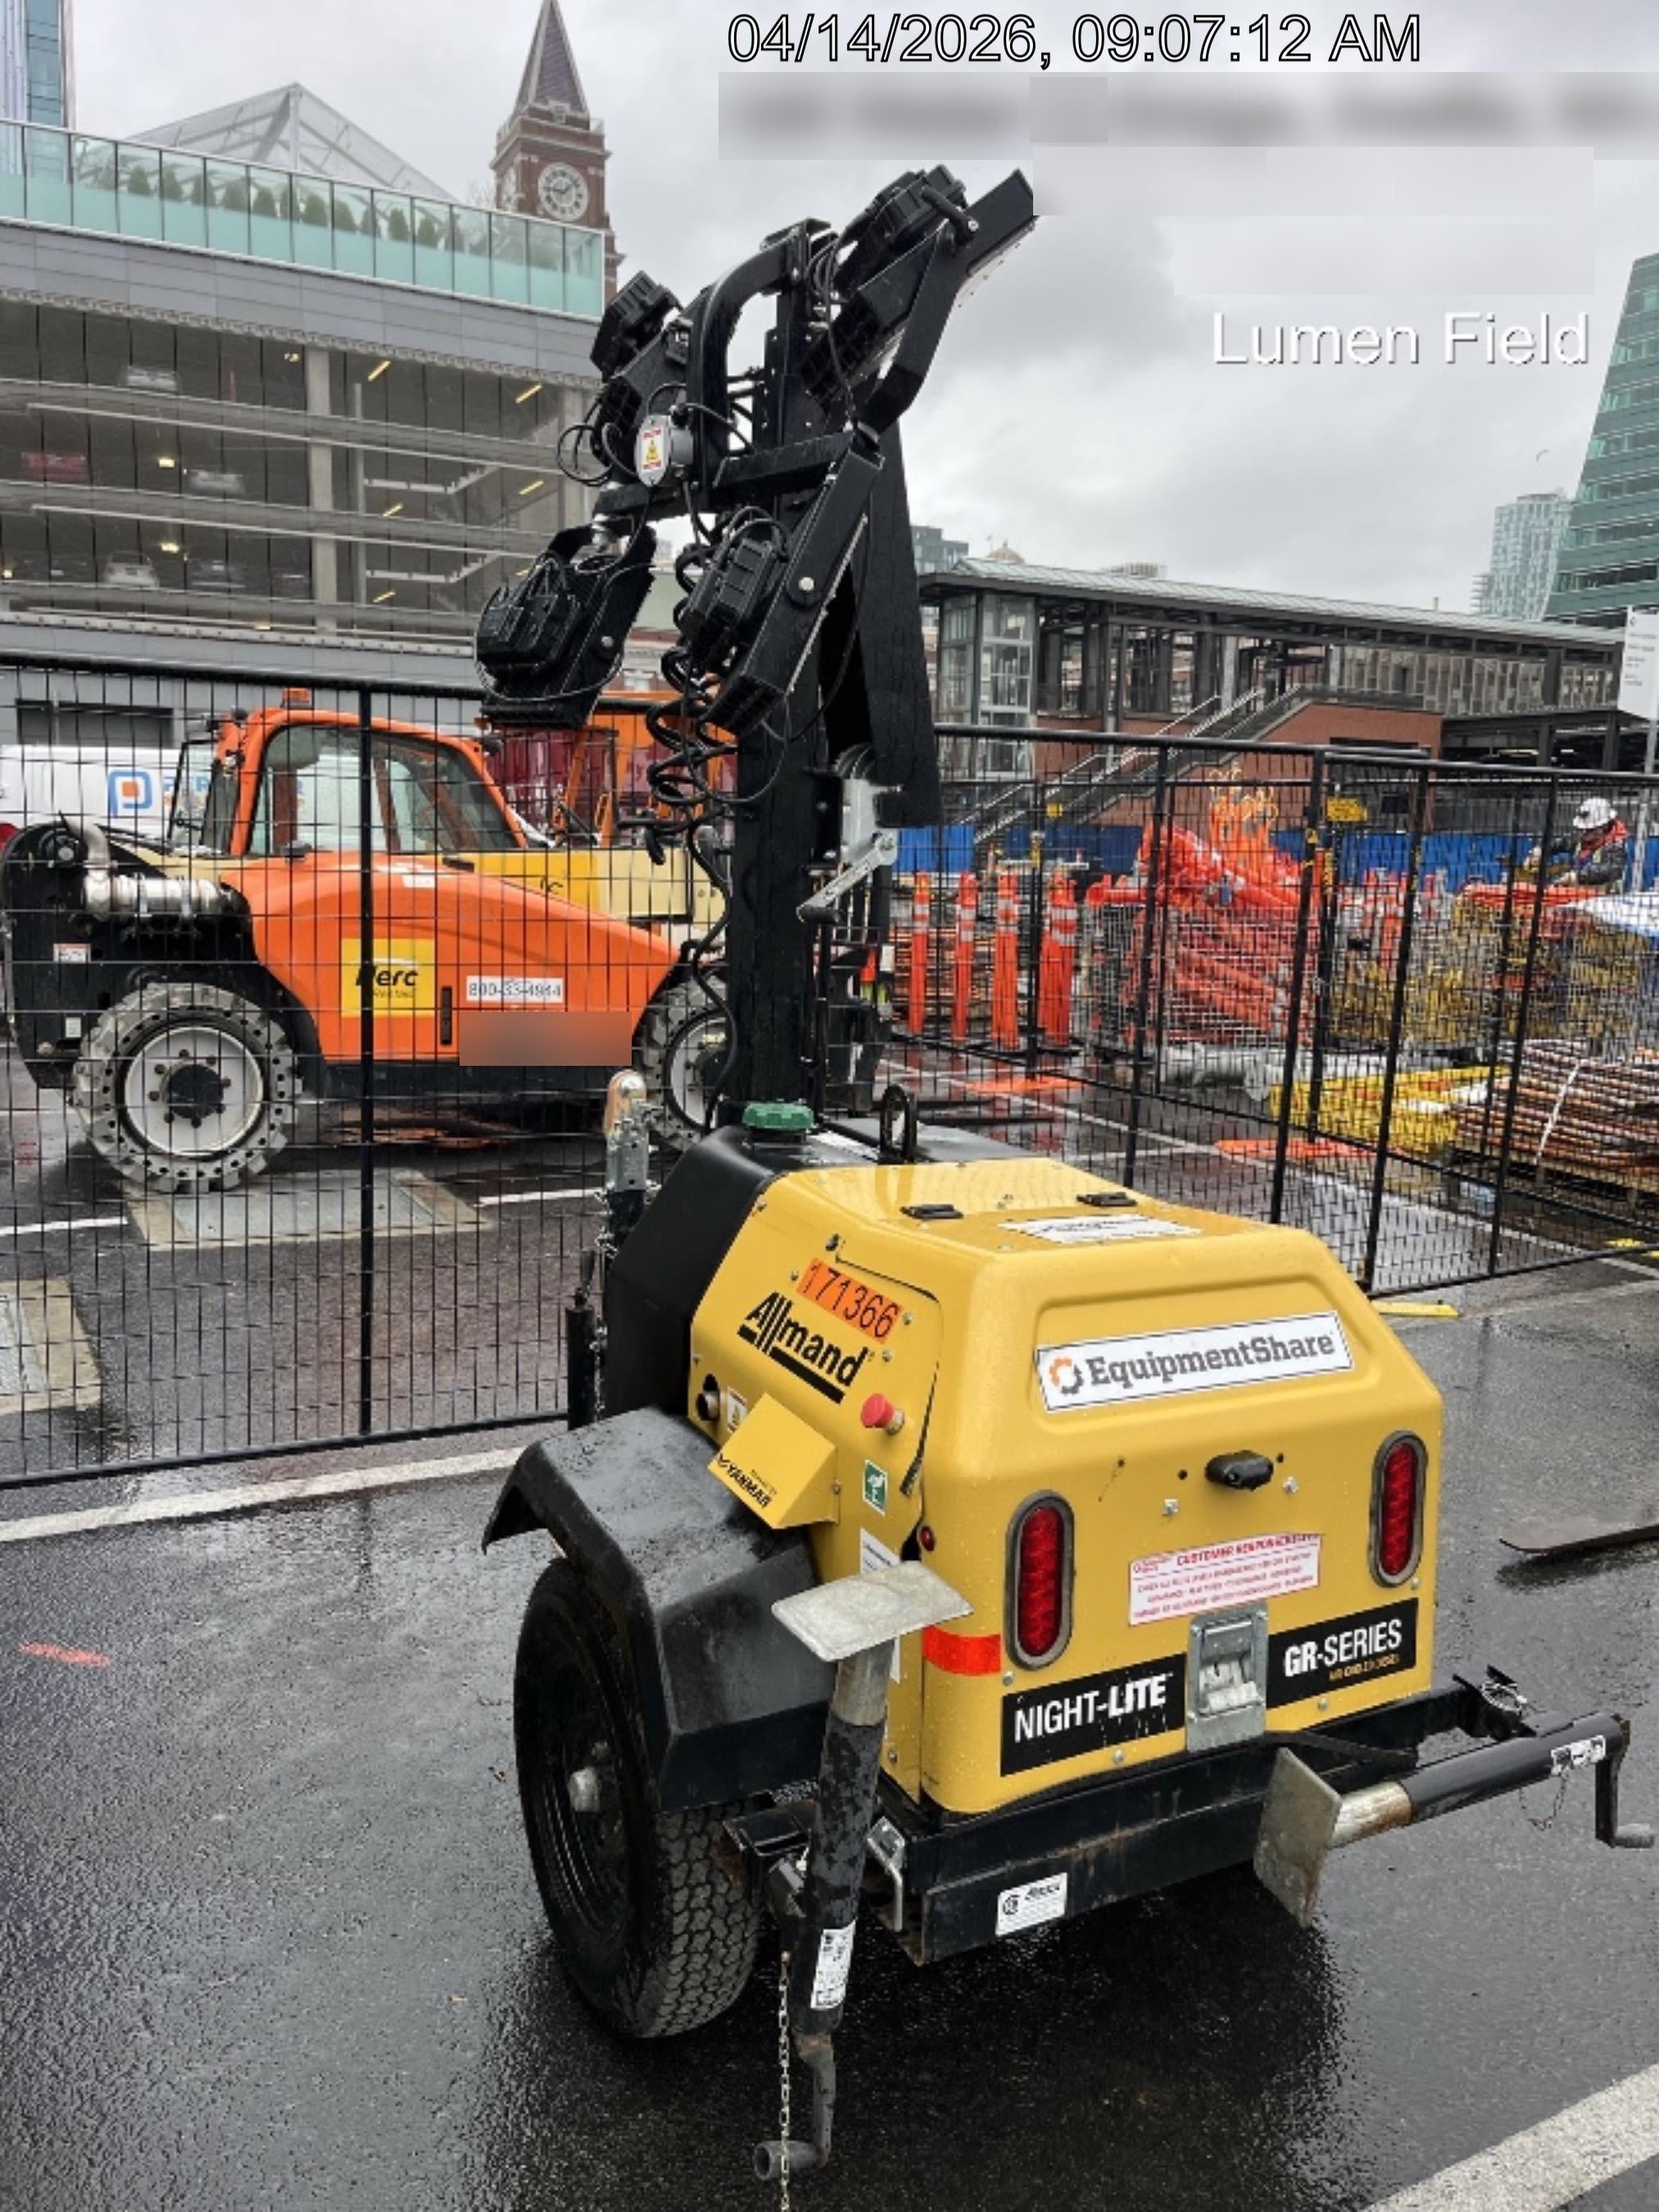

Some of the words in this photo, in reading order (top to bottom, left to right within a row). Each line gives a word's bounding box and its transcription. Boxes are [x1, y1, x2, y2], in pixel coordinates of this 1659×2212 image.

[803, 1262, 900, 1339] 171366
[746, 1291, 869, 1386] Allmand
[1086, 1332, 1335, 1389] EquipmentShare
[1284, 1618, 1403, 1677] GR-SERIES
[1013, 1672, 1168, 1743] NIGHT-LITE
